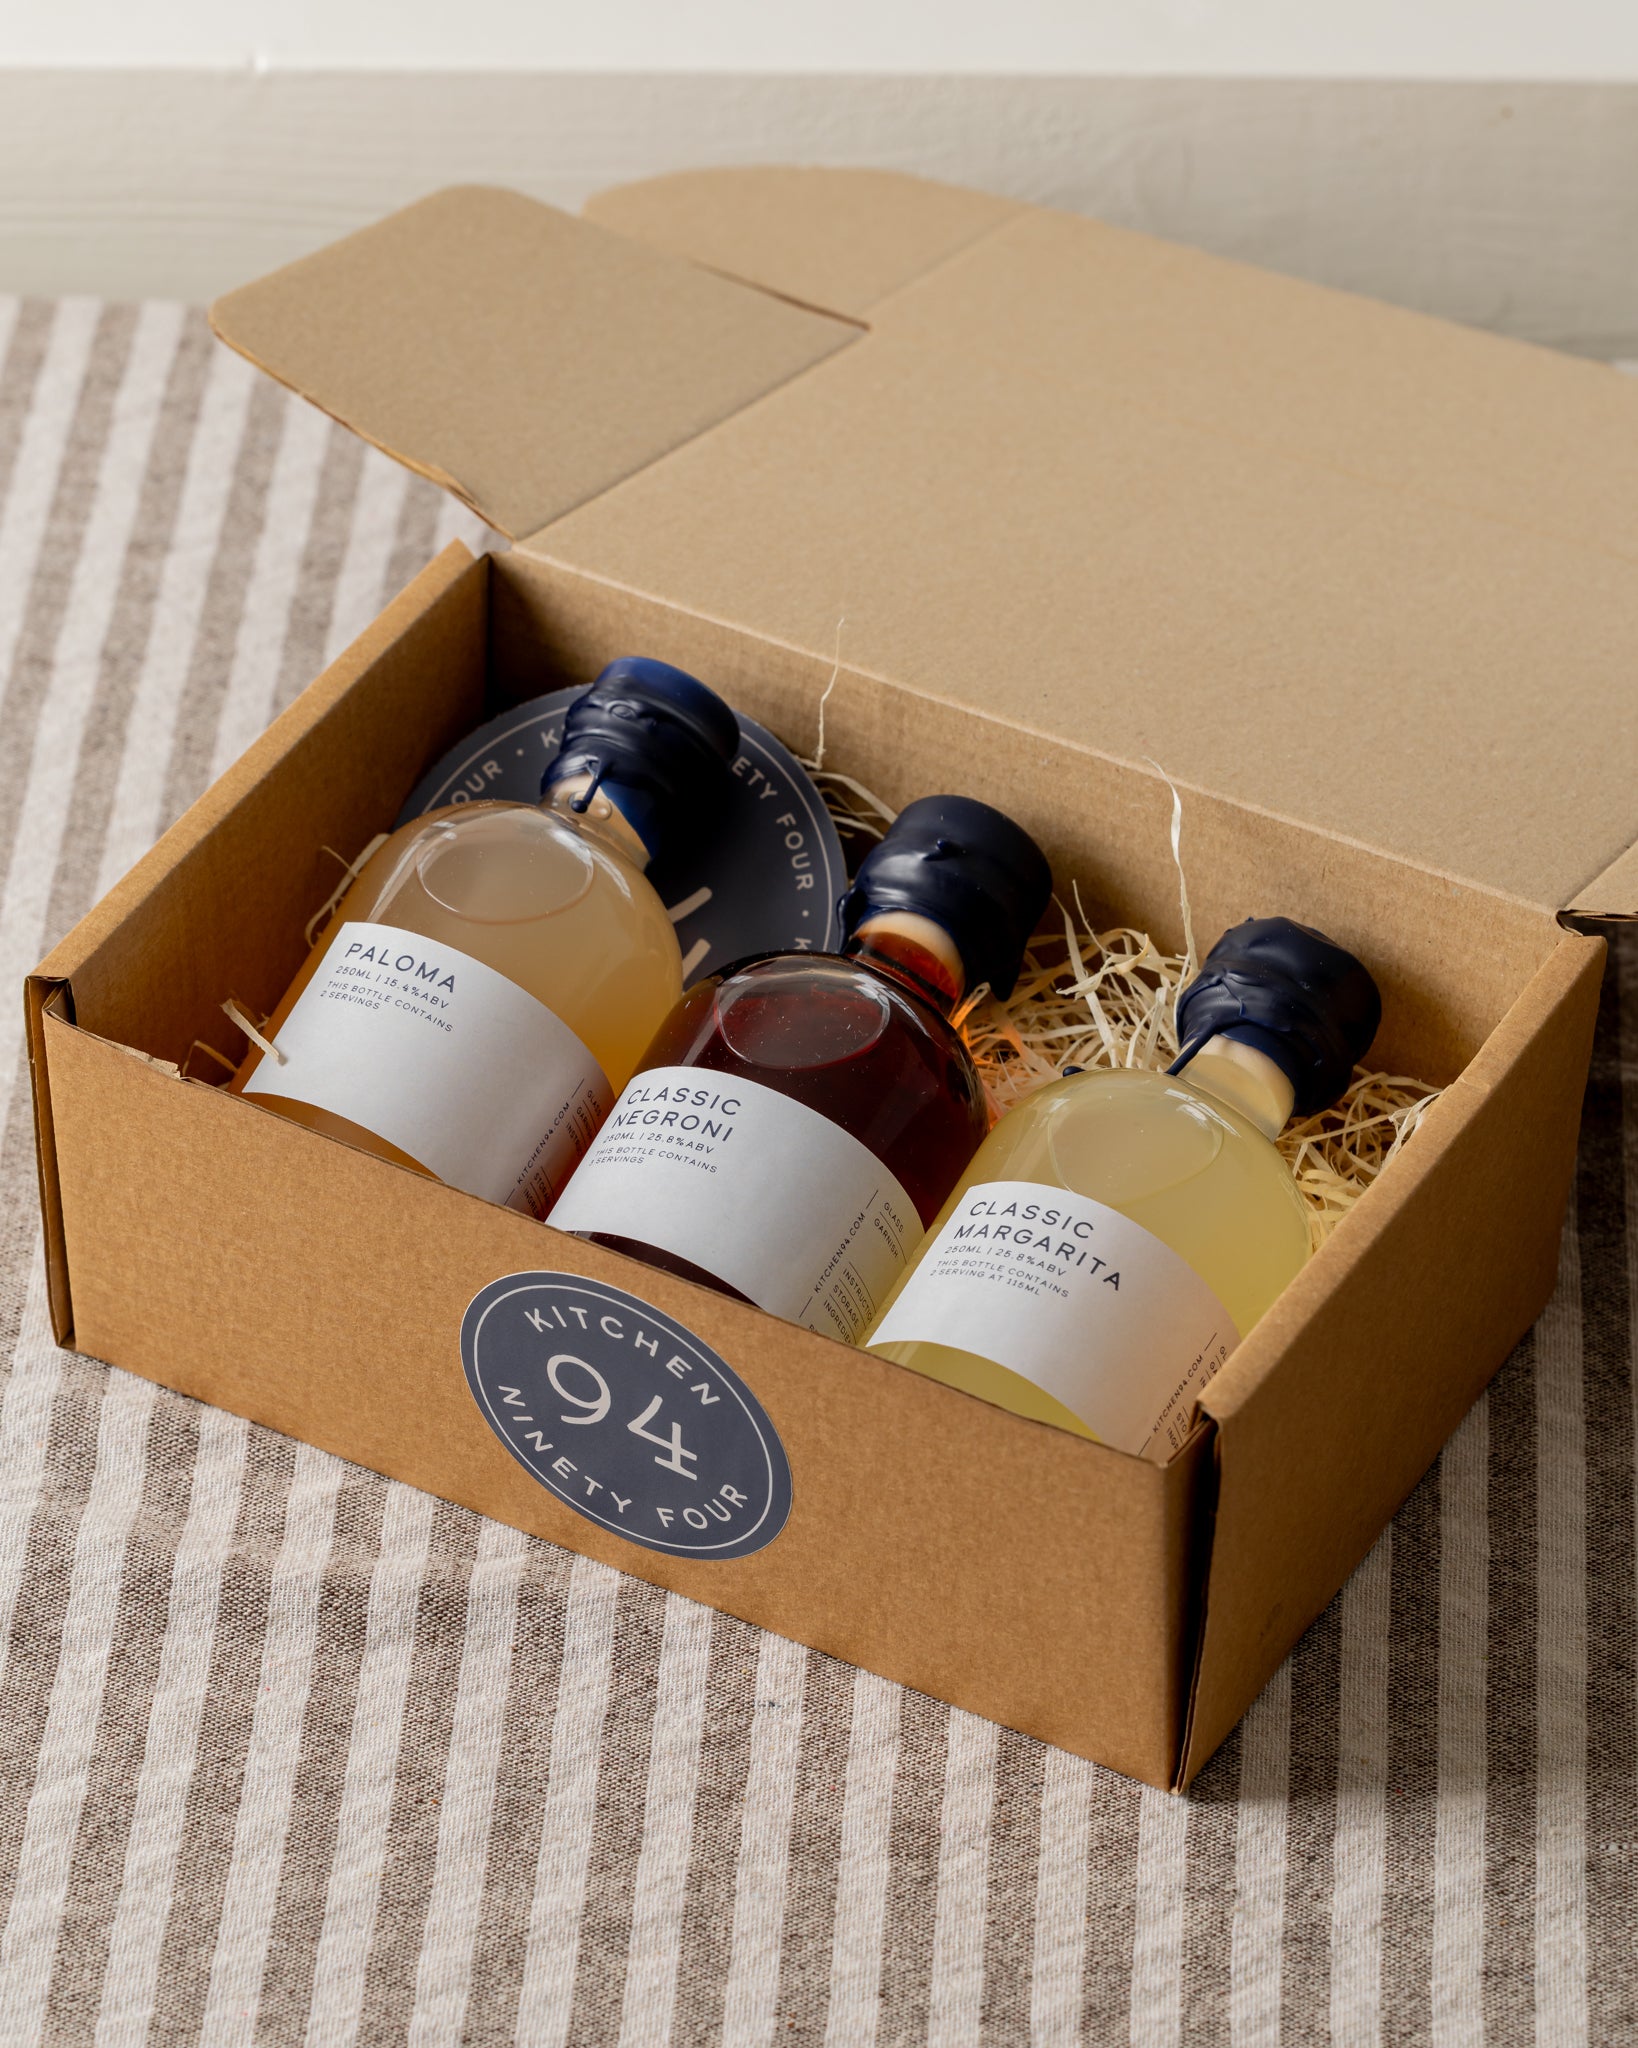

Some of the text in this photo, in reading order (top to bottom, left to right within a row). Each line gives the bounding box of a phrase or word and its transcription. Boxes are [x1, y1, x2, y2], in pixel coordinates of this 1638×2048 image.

[451, 760, 503, 804] OUR
[775, 812, 815, 891] FOUR
[335, 965, 372, 980] 250ML
[344, 943, 456, 993] PALOMA
[320, 990, 381, 1010] 2 SERVINGS
[327, 980, 454, 1032] THIS BOTTLE CONTAINS
[627, 1086, 742, 1115] CLASSIC
[517, 1102, 570, 1185] KITCHEN94.COM
[603, 1132, 636, 1144] 250ML
[647, 1132, 716, 1154] 25.8%ABV
[612, 1109, 734, 1142] NEGRONI
[595, 1156, 645, 1165] SERVINGS
[596, 1146, 718, 1174] THIS BOTTLE CONTAINS
[969, 1200, 1094, 1239] CLASSIC
[814, 1212, 866, 1294] KITCHEN94.COM
[944, 1245, 982, 1255] 250ML
[995, 1248, 1067, 1277] 25.8%ABV
[953, 1223, 1121, 1291] MARGARITA
[930, 1268, 1041, 1296] 2 SERVING AT 115ML
[937, 1259, 1069, 1298] THIS BOTTLE CONTAINS
[524, 1306, 720, 1405] KITCHEN
[1152, 1354, 1203, 1434] KITCHEN94.COM
[547, 1354, 697, 1481] 94
[498, 1385, 748, 1529] NINETY FOUR
